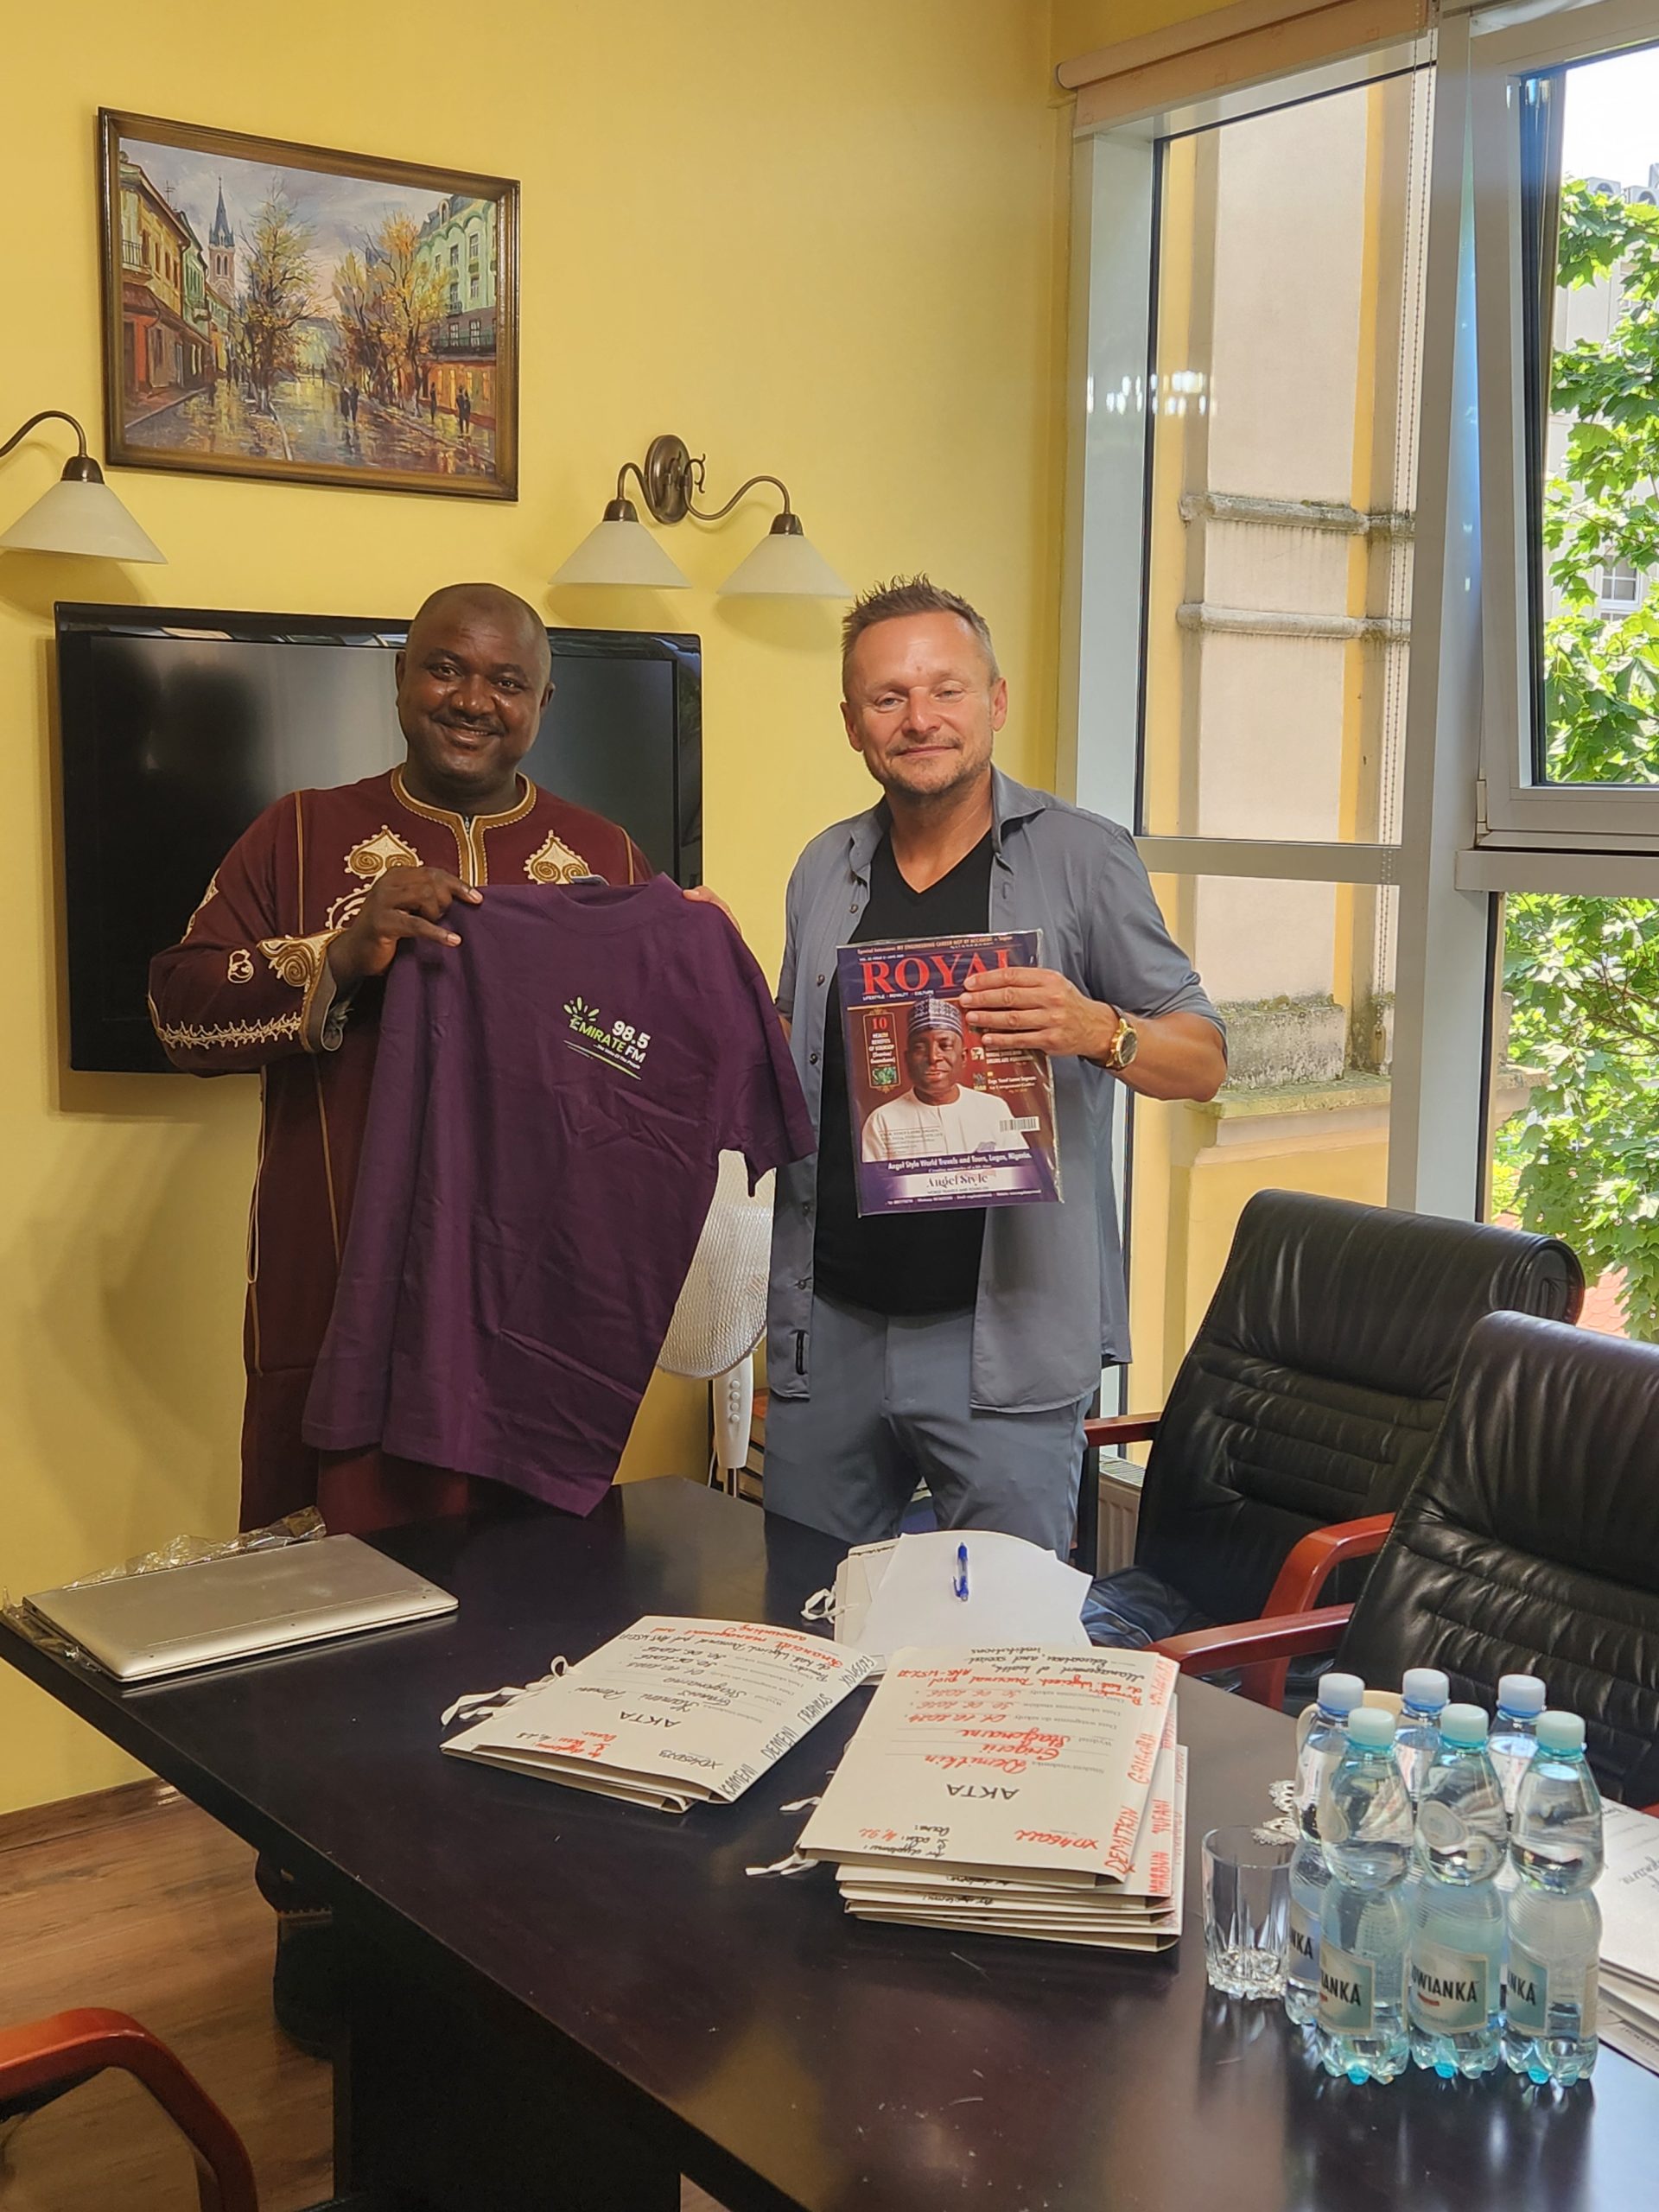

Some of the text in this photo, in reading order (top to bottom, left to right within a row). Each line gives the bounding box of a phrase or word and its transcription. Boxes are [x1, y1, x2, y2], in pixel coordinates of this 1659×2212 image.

[873, 1017, 887, 1030] 10
[569, 1017, 646, 1063] EMIRATE FM
[612, 1020, 651, 1049] 98.5
[920, 1159, 938, 1167] World
[926, 1173, 988, 1189] Angel Style
[682, 1627, 767, 1643] management
[738, 1624, 807, 1642] accounting
[774, 1642, 843, 1669] Financial
[1037, 1665, 1051, 1675] of
[1059, 1667, 1146, 1683] Management
[1128, 1686, 1142, 1694] dr
[619, 1711, 681, 1728] AKTA
[980, 1740, 1059, 1761] Grigorii
[924, 1755, 1027, 1774] Demitkin
[946, 1784, 1020, 1800] AKTA
[1104, 1806, 1138, 1875] DEMITKIN
